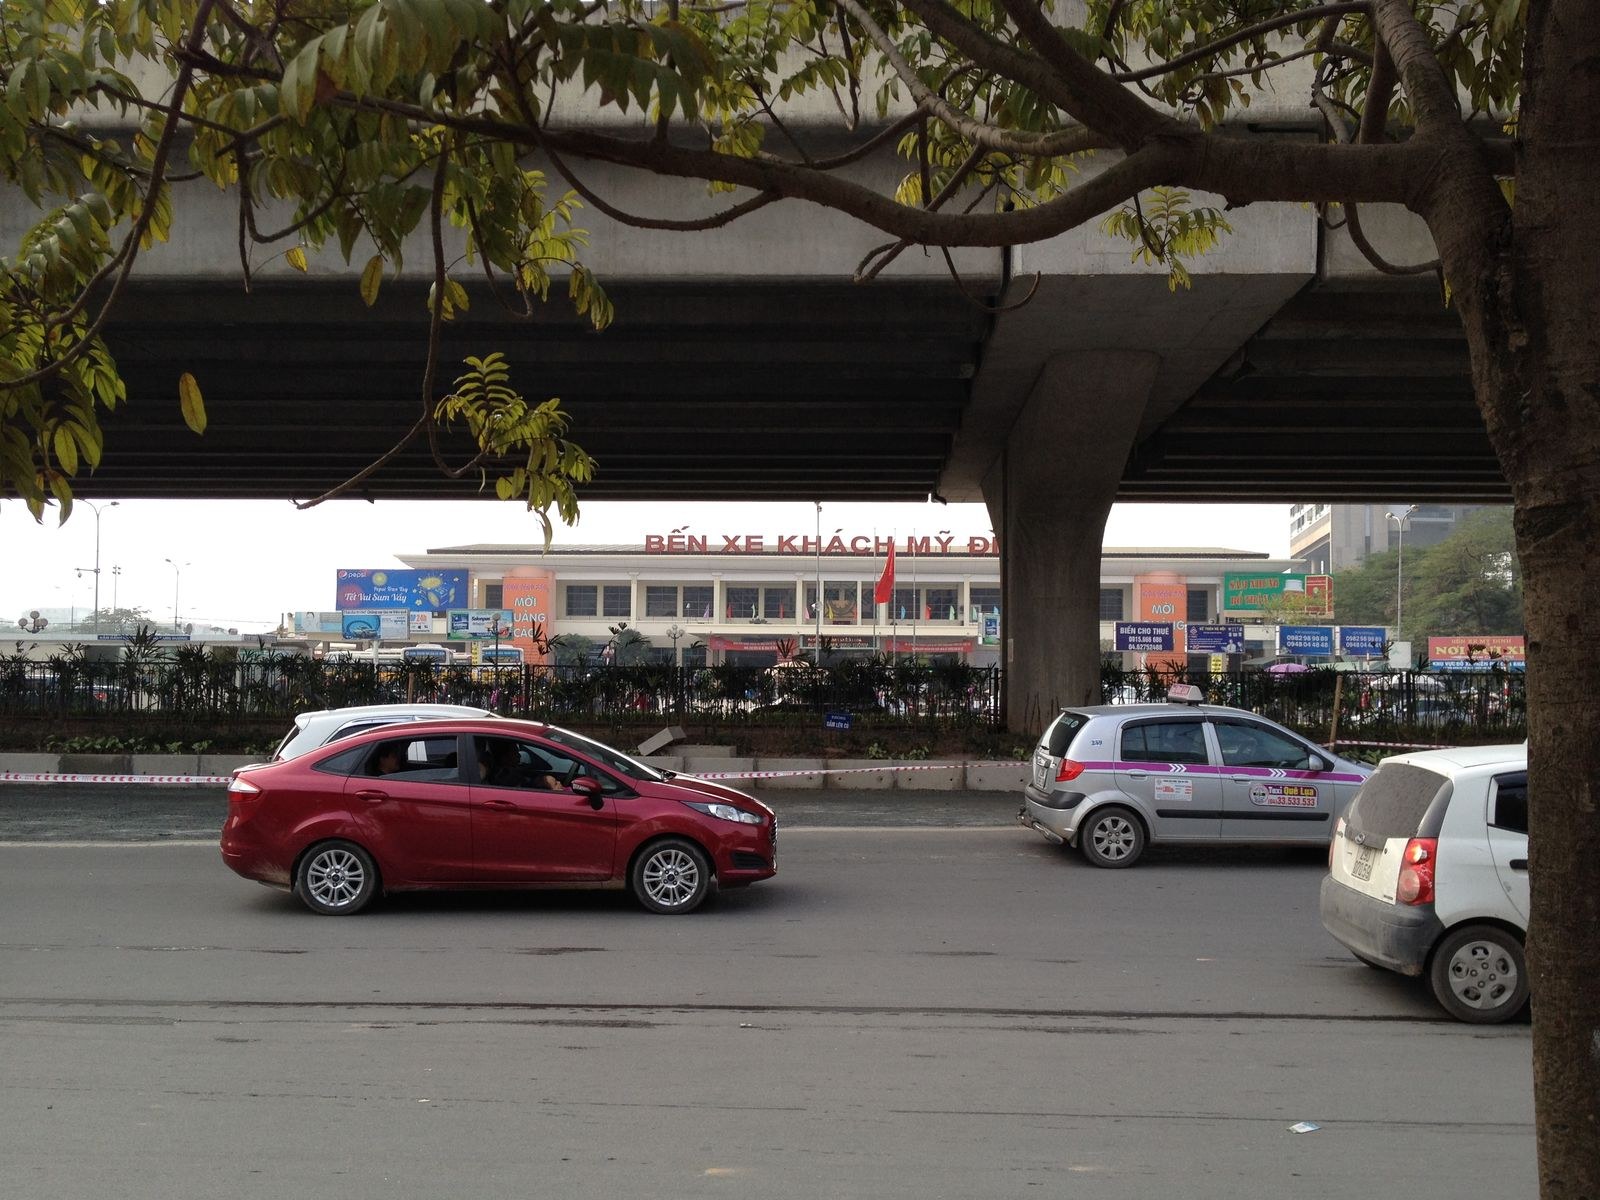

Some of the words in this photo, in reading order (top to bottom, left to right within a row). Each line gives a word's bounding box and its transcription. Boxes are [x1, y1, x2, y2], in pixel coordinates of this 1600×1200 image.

[645, 525, 707, 553] BẾN
[722, 535, 764, 553] XE
[778, 528, 895, 554] KHÁCH
[907, 530, 955, 554] MỸ
[967, 529, 1000, 554] ĐÌ
[348, 571, 366, 579] pepsi
[358, 593, 371, 601] Vui
[514, 595, 536, 607] MỜI
[1152, 602, 1175, 615] MỜI
[513, 610, 546, 623] UẢNG
[1137, 627, 1151, 635] CHO
[1268, 786, 1283, 794] Taxi
